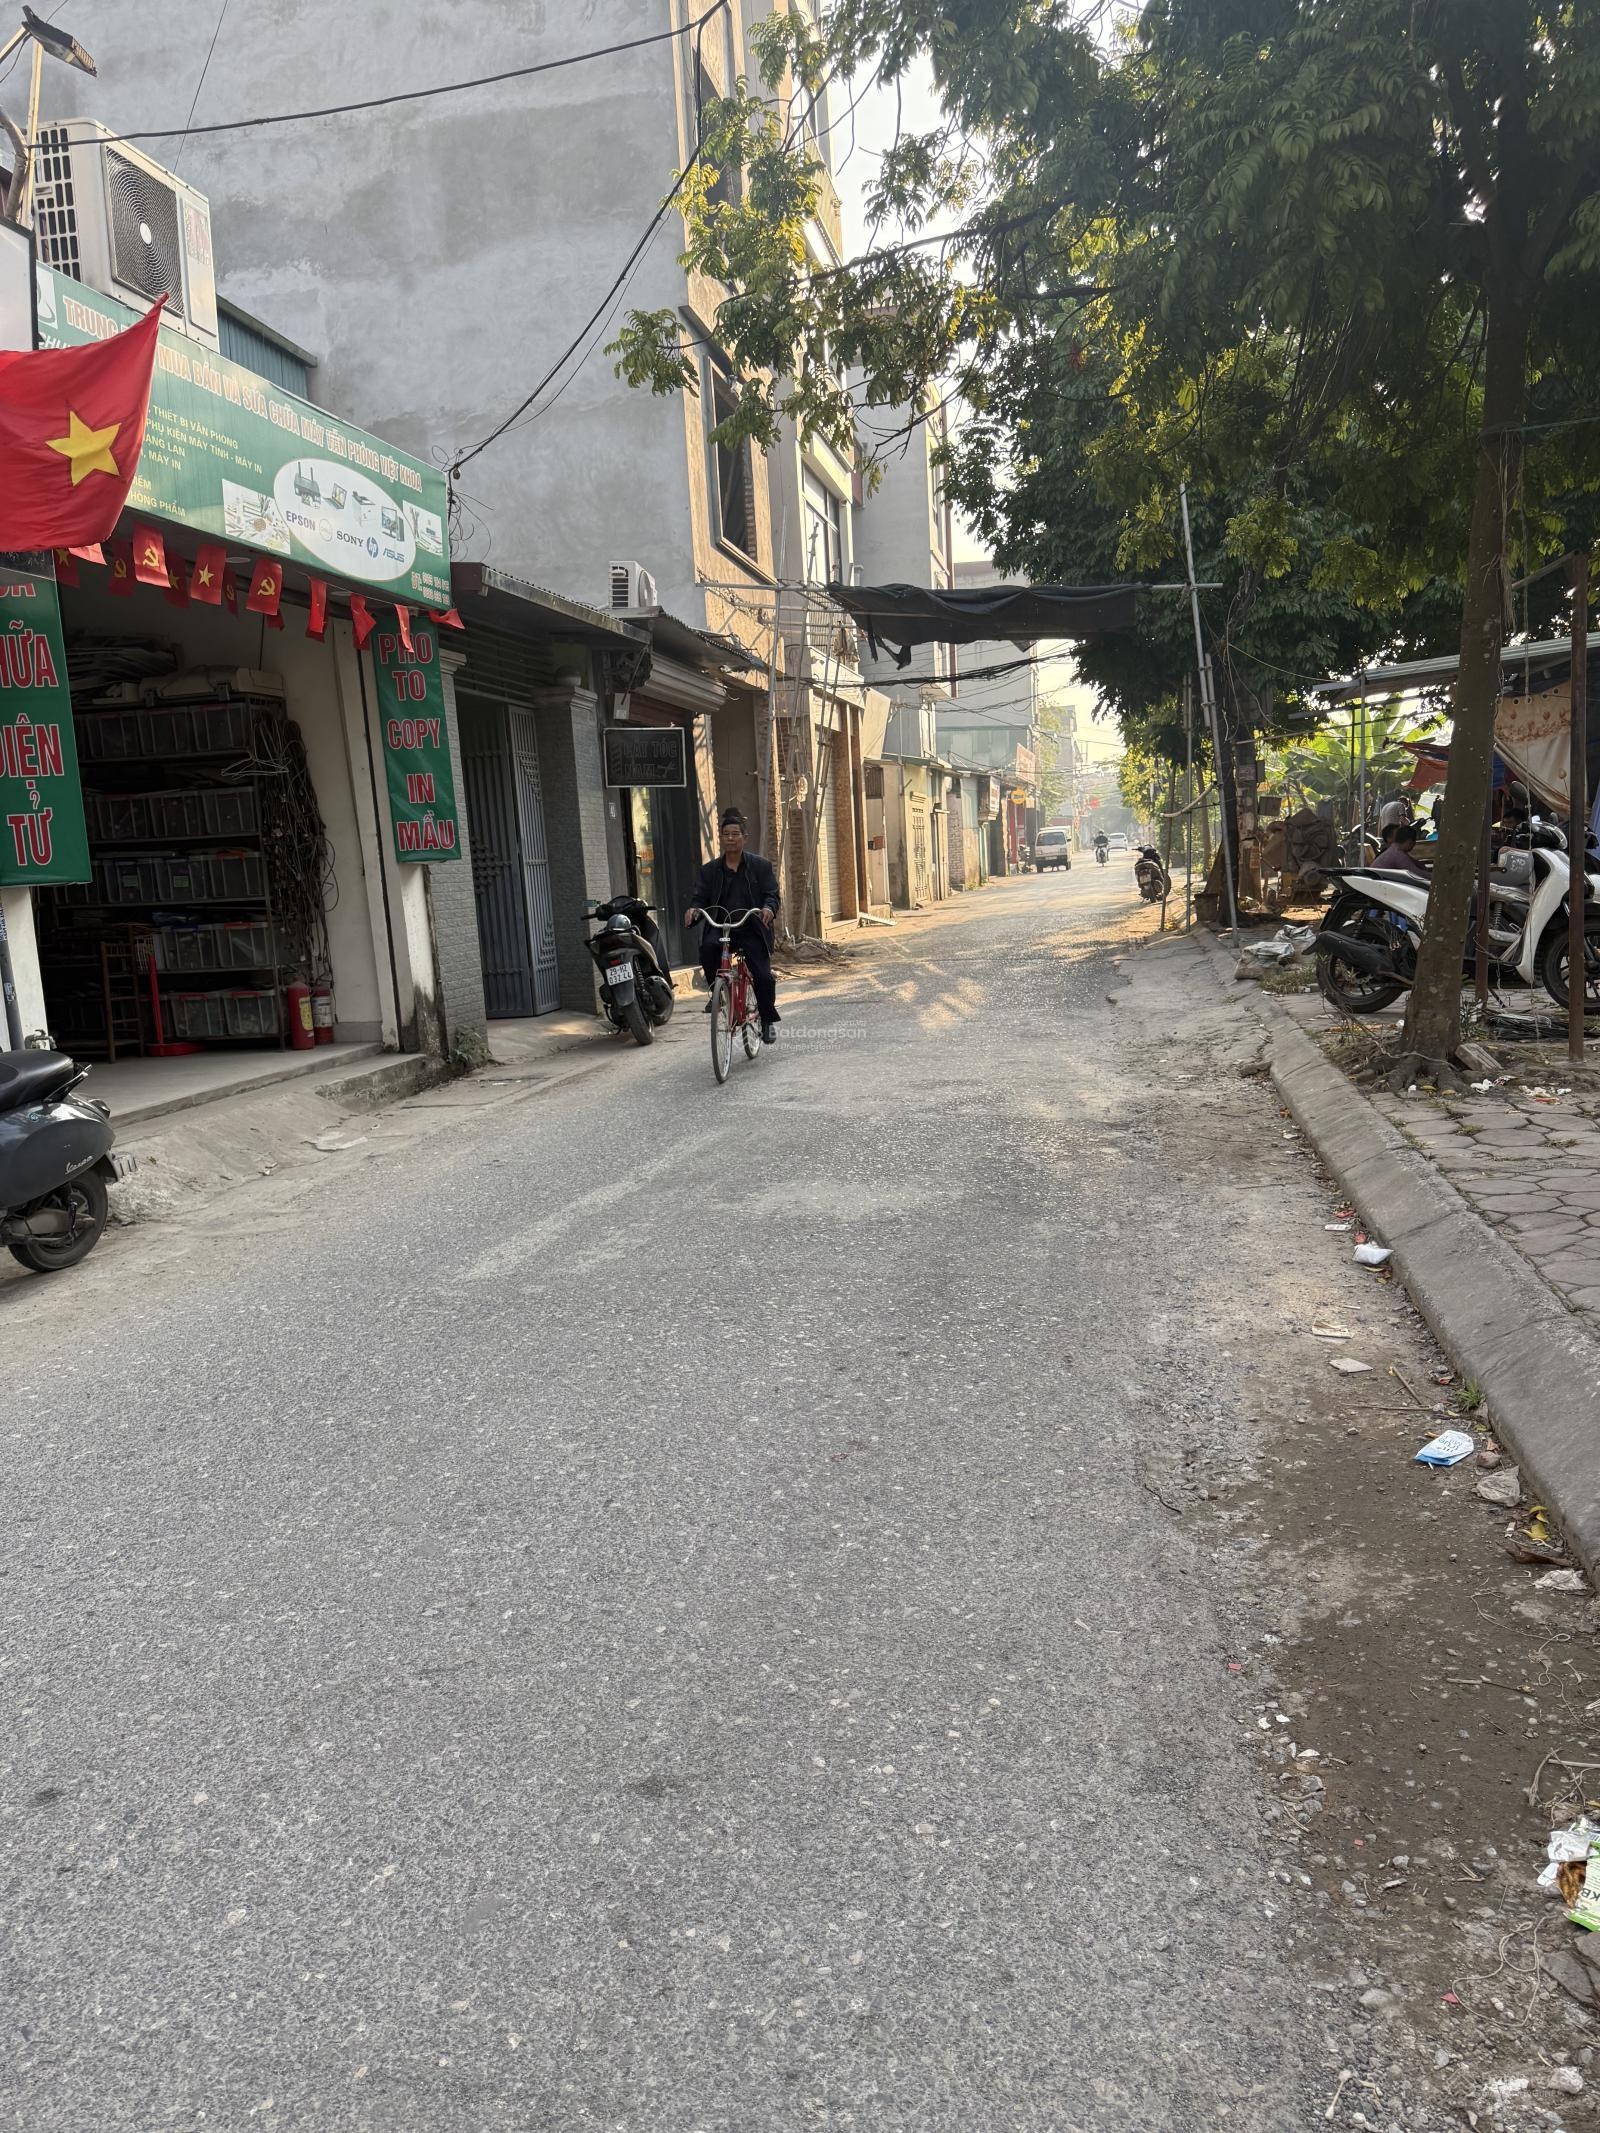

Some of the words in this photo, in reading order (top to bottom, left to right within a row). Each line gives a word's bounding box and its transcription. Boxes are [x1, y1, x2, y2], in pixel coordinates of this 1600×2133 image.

[63, 295, 118, 340] TRUNG
[157, 342, 192, 382] MUA
[192, 360, 222, 397] BÁN
[222, 374, 241, 406] VÀ
[242, 383, 268, 419] SỬA
[268, 400, 300, 436] CHỮA
[301, 416, 324, 447] MÁY
[348, 440, 379, 472] PHÒNG
[380, 454, 398, 483] VIỆT
[399, 464, 422, 492] KHOA
[152, 405, 177, 423] THIẾT
[180, 417, 188, 431] BỊ
[190, 420, 209, 437] VĂN
[210, 430, 238, 449] PHÒNG
[145, 433, 165, 449] ẠNG
[167, 442, 185, 457] LAN
[146, 418, 164, 435] PHỤ
[166, 424, 187, 443] KIỆN
[188, 435, 209, 451] MÁY
[210, 443, 229, 460] TÍNH
[235, 455, 253, 469] MÁY
[254, 463, 262, 474] IN
[148, 450, 169, 465] MÁY
[172, 459, 181, 470] IN
[128, 491, 157, 507] HÒNG
[286, 511, 315, 531] EPSON
[337, 531, 363, 547] SONY
[382, 548, 404, 563] ASUS
[392, 670, 426, 701] TO
[388, 718, 440, 750] COPY
[407, 773, 435, 804] IN
[7, 791, 53, 866] TỬ
